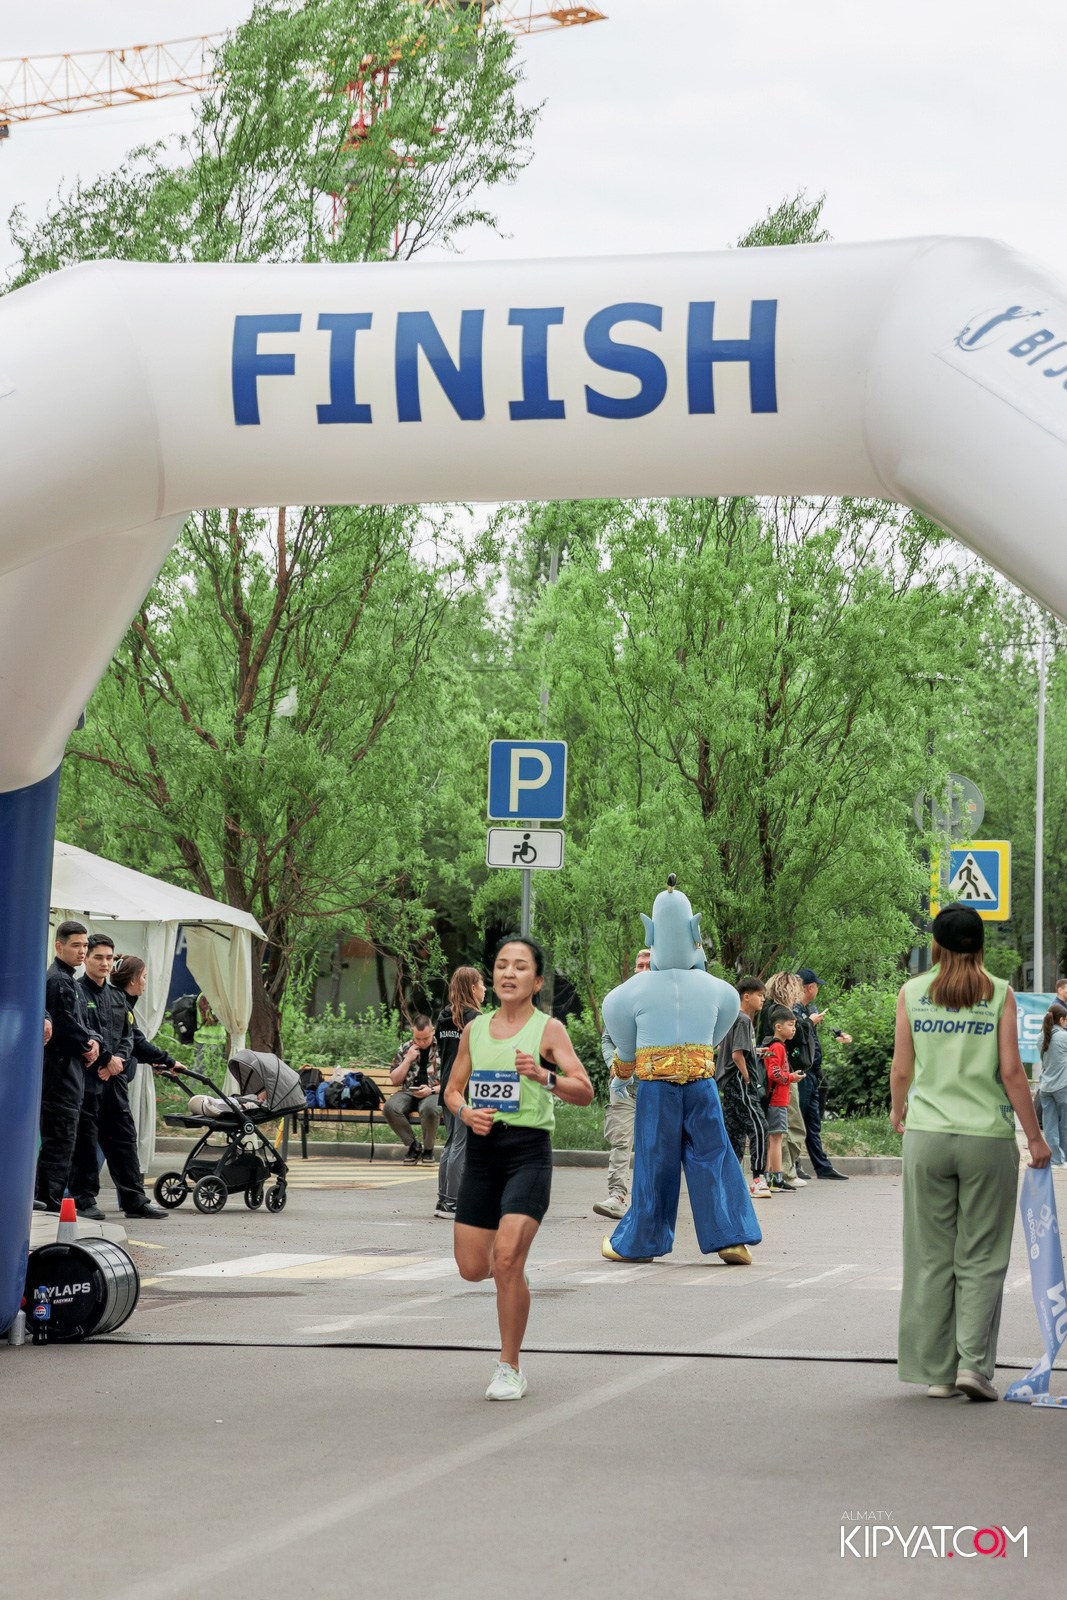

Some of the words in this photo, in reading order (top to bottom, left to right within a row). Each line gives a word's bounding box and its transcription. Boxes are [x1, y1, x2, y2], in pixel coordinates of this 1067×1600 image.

[231, 298, 779, 427] FINISH
[509, 748, 552, 812] P
[913, 1019, 995, 1035] ВОЛОНТЕР
[474, 1083, 513, 1098] 1828
[33, 1282, 91, 1300] MYLAPS
